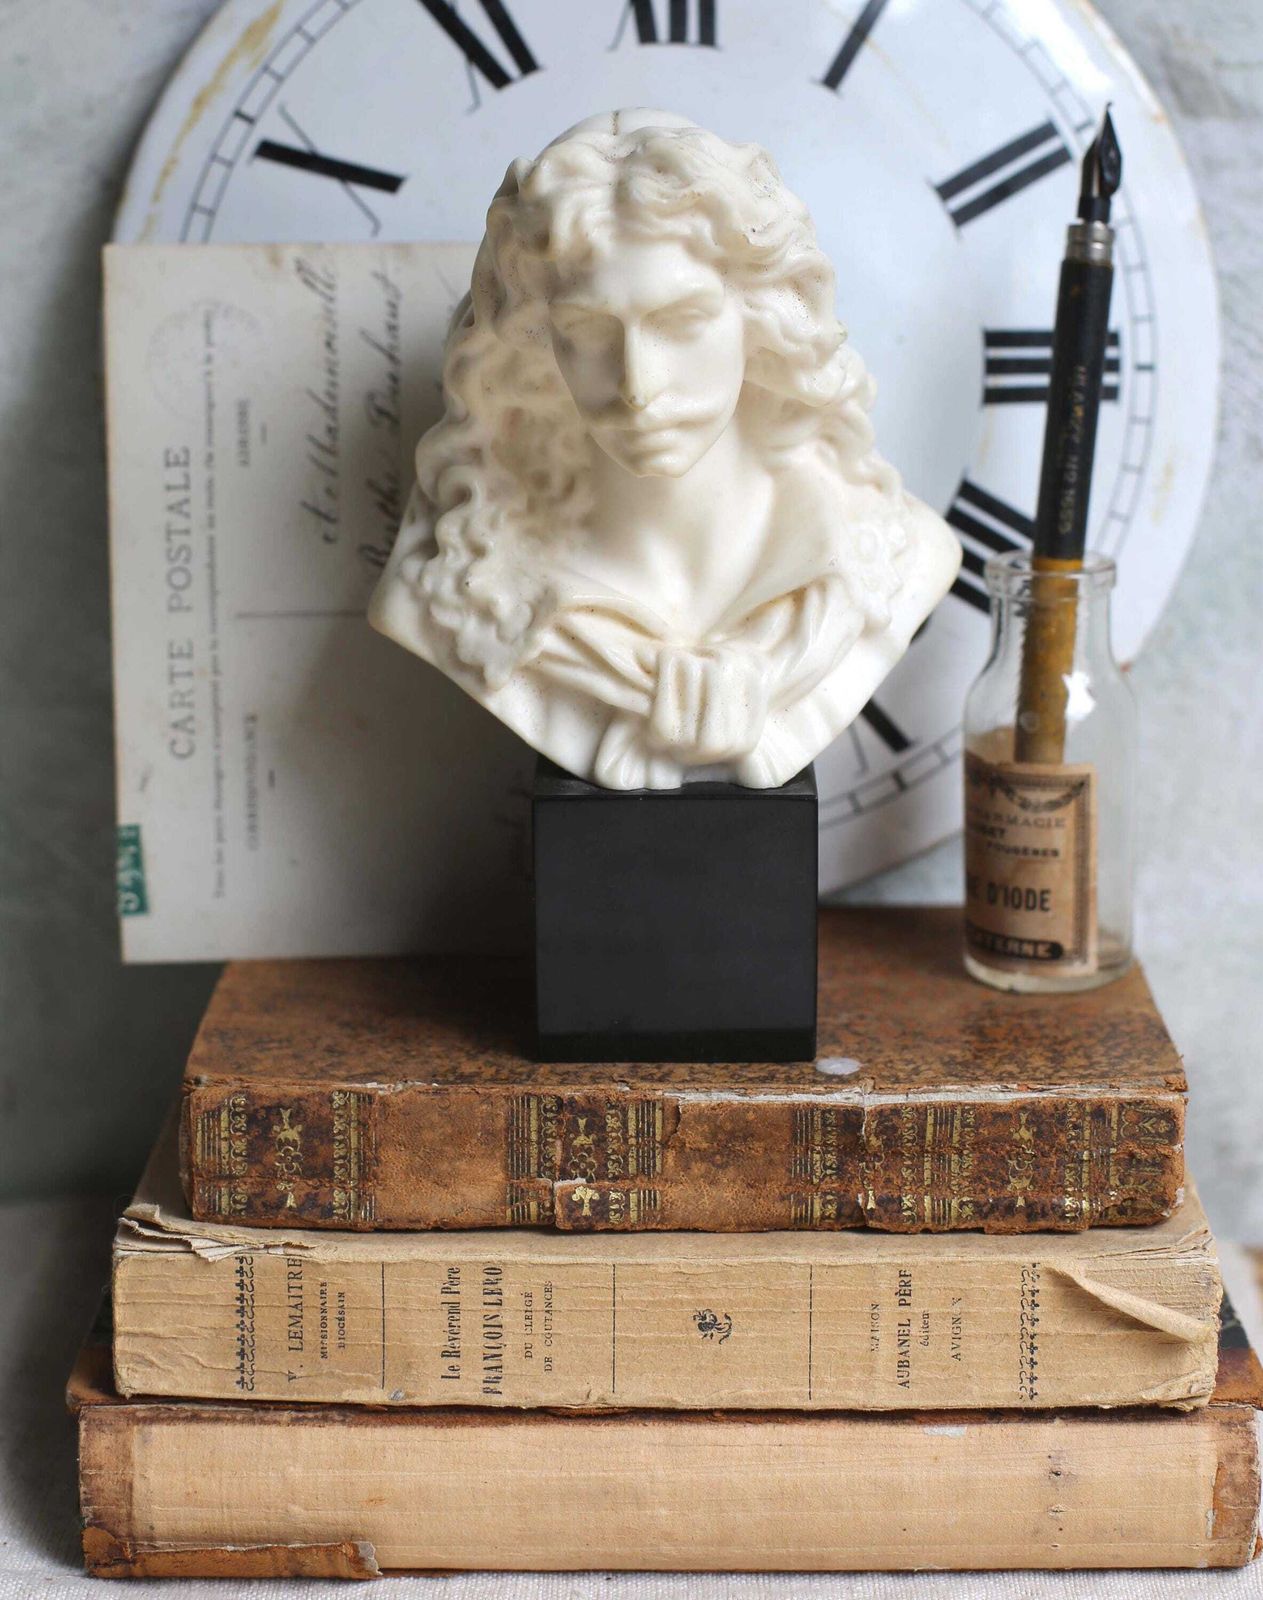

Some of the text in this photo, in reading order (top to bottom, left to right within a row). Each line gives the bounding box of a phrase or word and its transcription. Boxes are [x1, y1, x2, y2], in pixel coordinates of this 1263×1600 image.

[163, 445, 197, 761] CARTE POSTALE
[440, 1266, 461, 1380] Le Révérend Père
[482, 1313, 507, 1395] FRANÇOIS
[523, 1342, 533, 1359] DU
[896, 1318, 913, 1389] AUBANEL
[918, 1309, 931, 1348] éditeu
[950, 1296, 963, 1362] AVIGNN
[543, 1356, 554, 1373] DE
